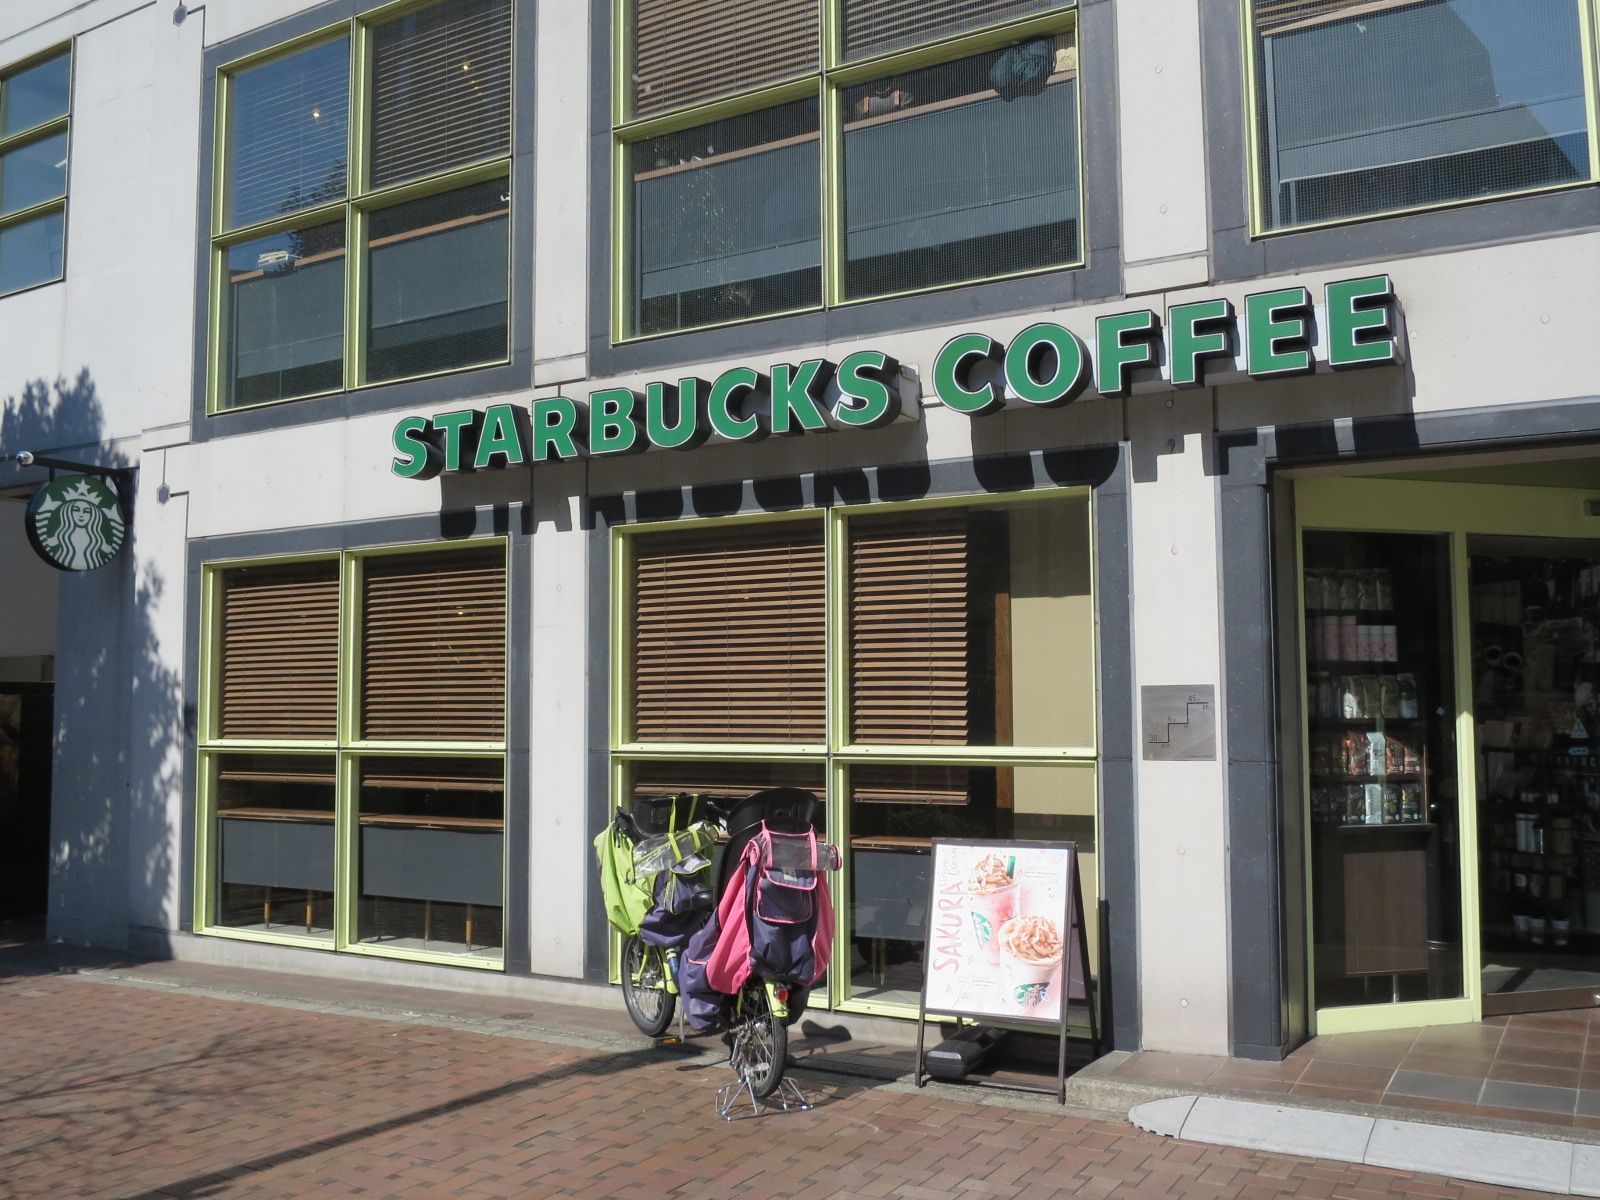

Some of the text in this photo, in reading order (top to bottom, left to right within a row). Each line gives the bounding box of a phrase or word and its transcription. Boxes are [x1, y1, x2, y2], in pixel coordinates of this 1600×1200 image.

[391, 274, 1395, 479] STARBUCKS COFFEE
[932, 879, 966, 974] SAKURA
